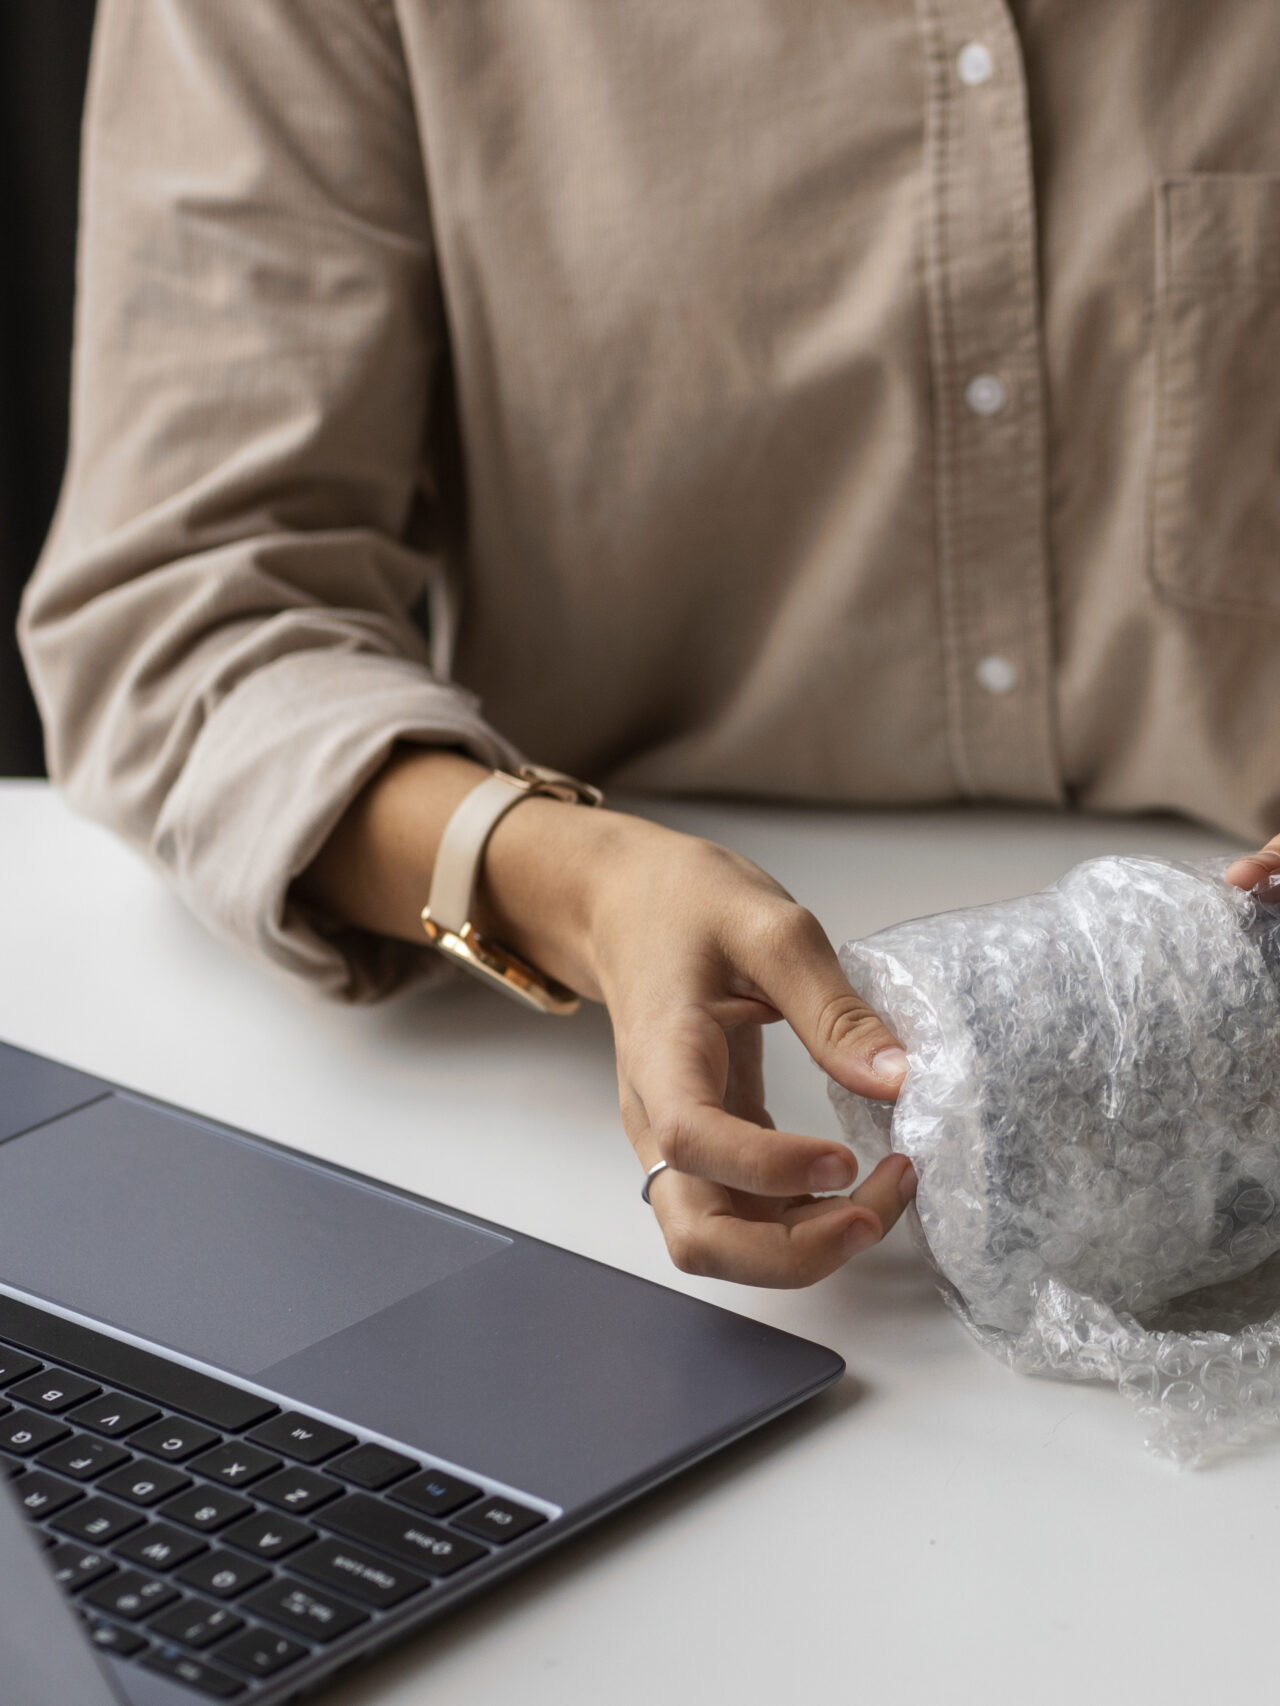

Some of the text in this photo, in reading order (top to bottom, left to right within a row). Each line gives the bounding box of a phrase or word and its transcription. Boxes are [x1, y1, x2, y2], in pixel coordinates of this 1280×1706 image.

[41, 1390, 64, 1401] B
[100, 1415, 120, 1426] V
[11, 1431, 32, 1443] G
[291, 1428, 313, 1440] Alt
[162, 1438, 183, 1450] C
[69, 1458, 92, 1469] F
[222, 1462, 247, 1476] X
[132, 1481, 155, 1495] D
[24, 1492, 47, 1507] R
